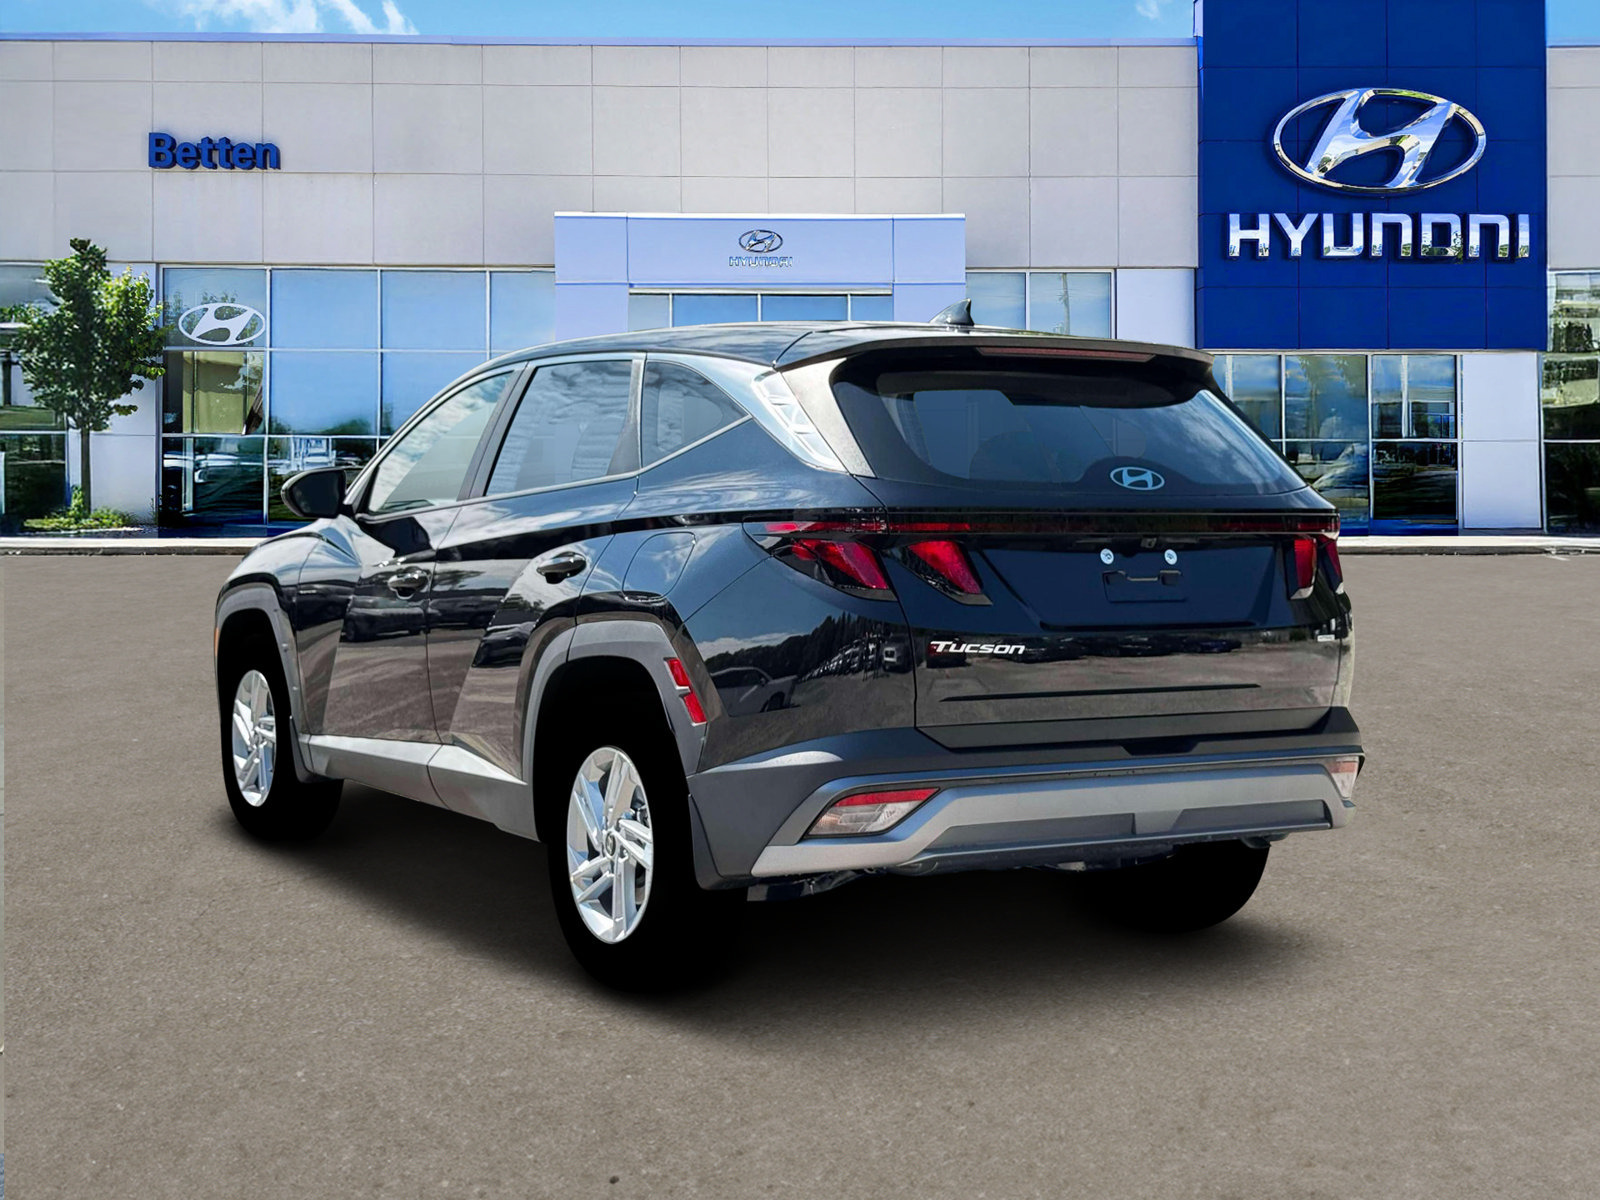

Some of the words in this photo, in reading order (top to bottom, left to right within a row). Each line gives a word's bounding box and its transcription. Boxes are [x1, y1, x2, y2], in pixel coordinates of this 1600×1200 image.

[149, 132, 281, 170] Betten
[1228, 212, 1530, 258] HYUNDAI
[728, 256, 793, 267] HYUNDAI
